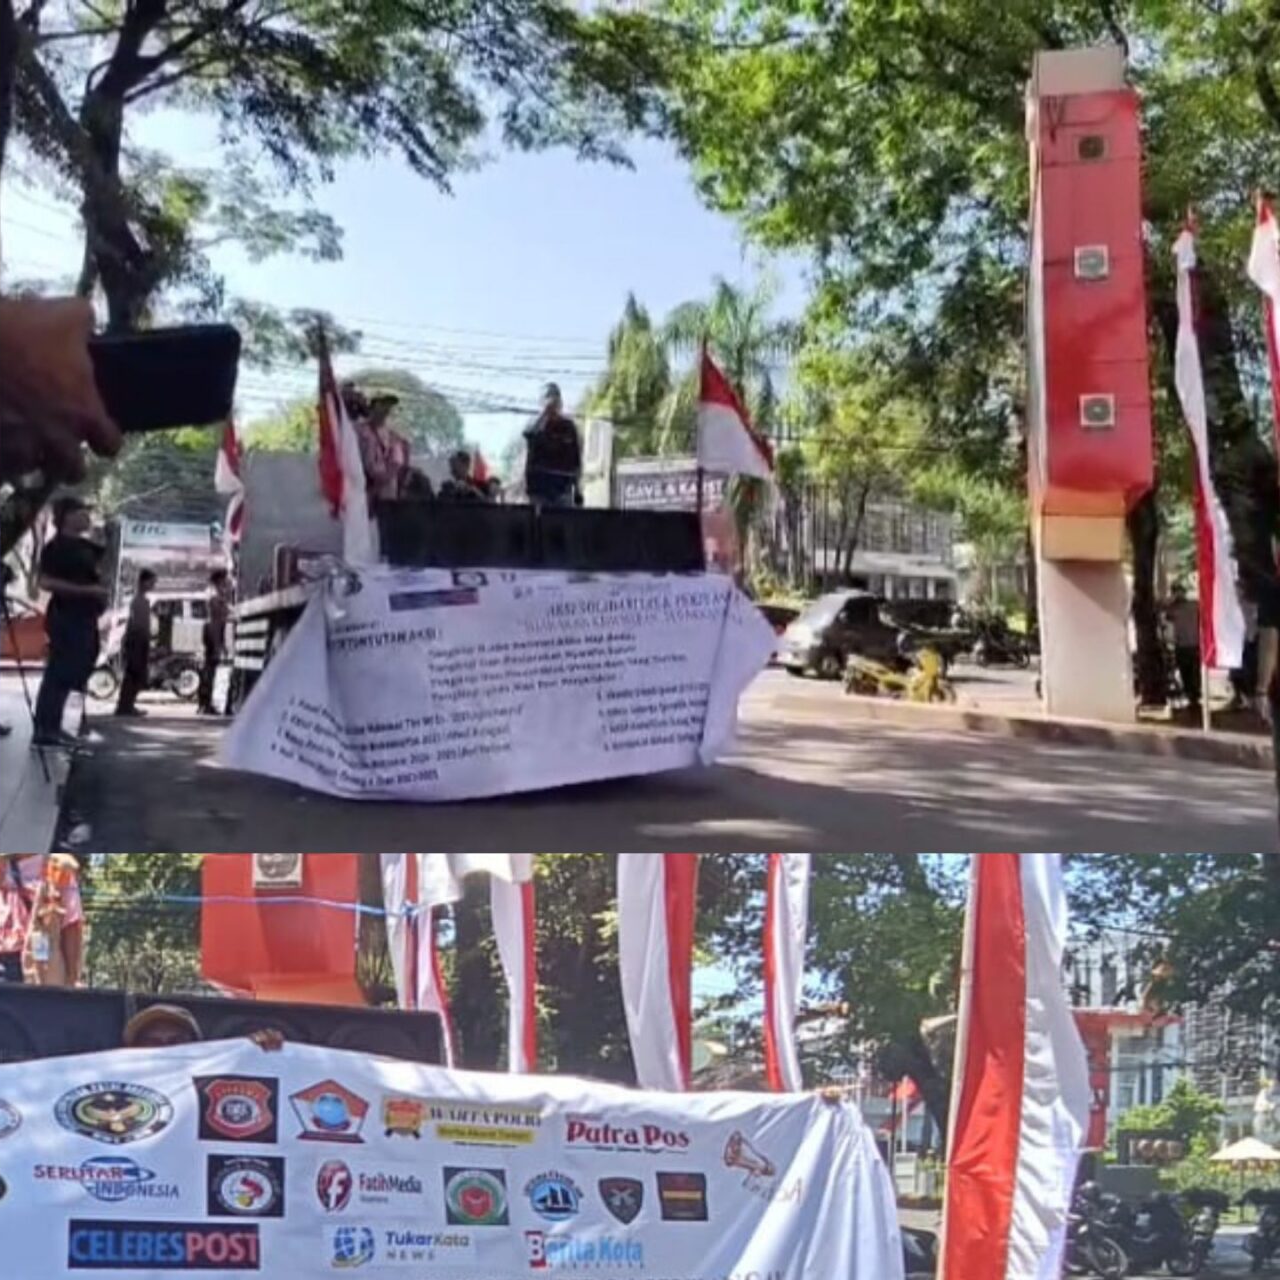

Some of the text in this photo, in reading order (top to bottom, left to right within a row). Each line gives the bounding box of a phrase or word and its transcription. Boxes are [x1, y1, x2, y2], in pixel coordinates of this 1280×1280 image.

[567, 1121, 690, 1148] Putra Pos
[386, 1230, 469, 1248] TukarKata
